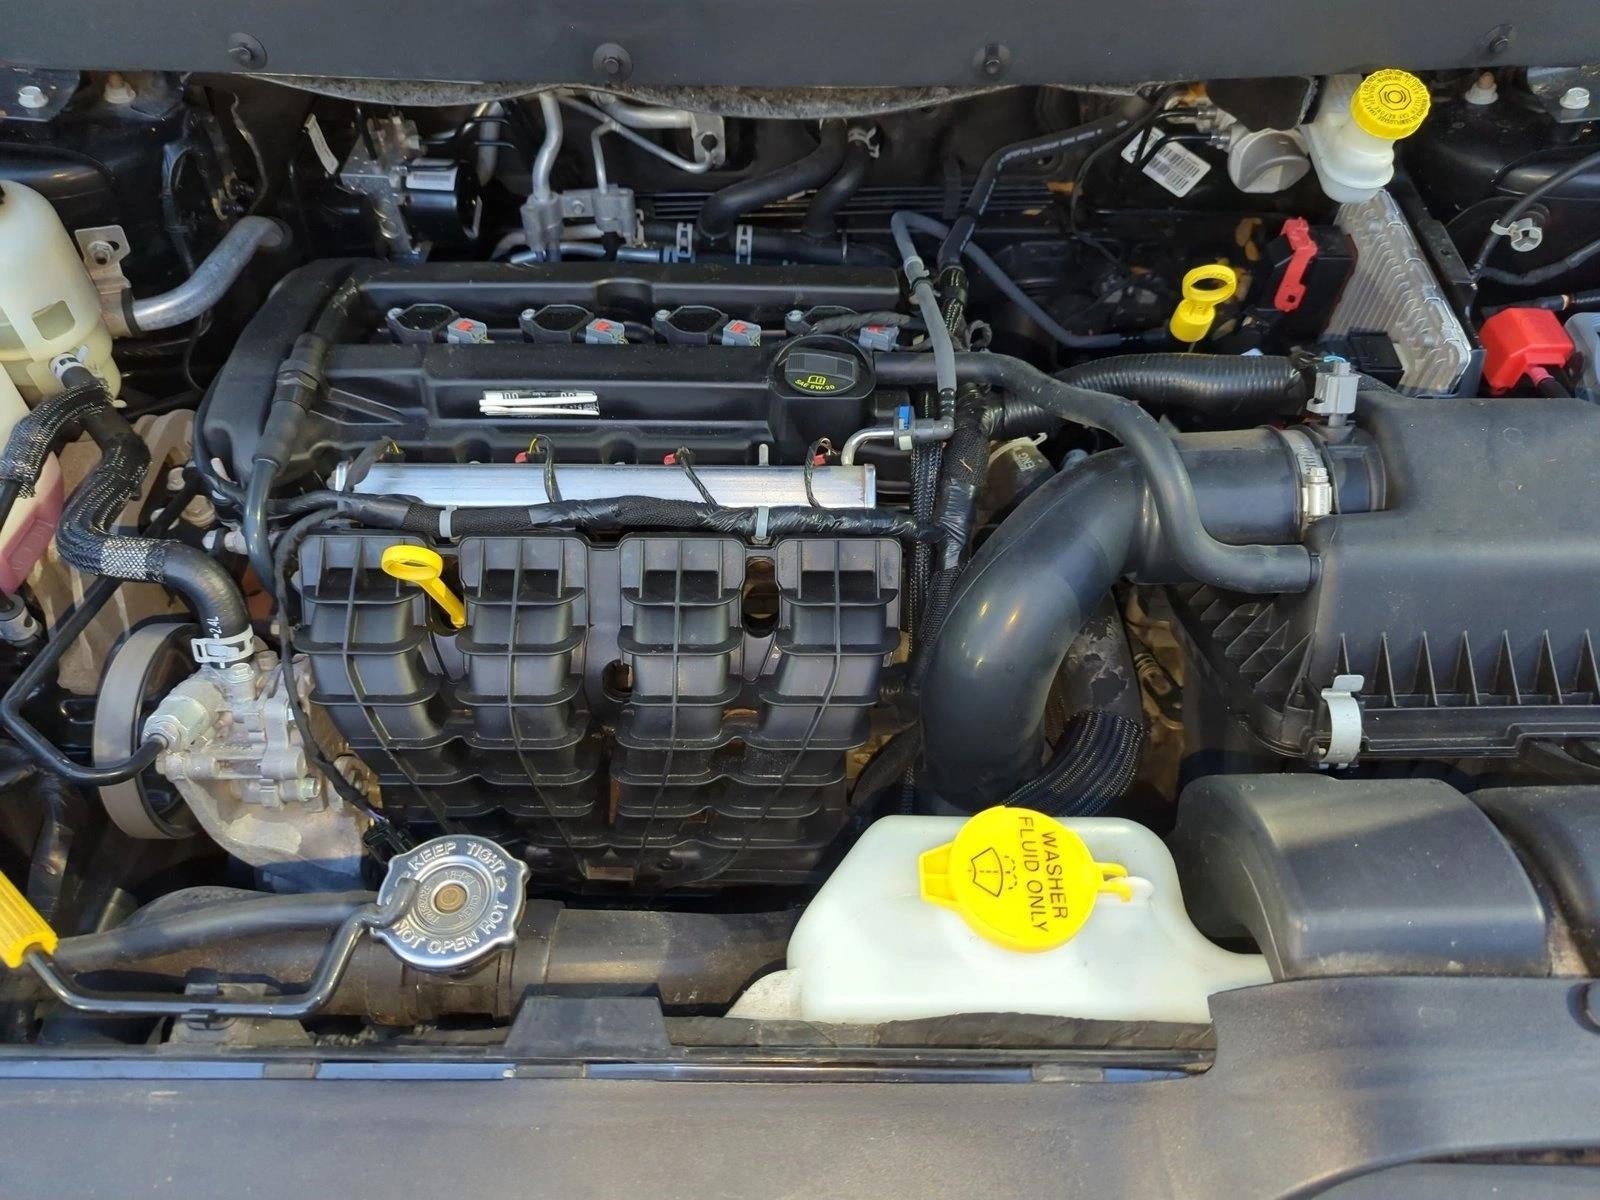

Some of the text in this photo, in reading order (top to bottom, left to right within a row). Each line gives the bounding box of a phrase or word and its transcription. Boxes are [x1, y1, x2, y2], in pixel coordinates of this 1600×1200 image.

[206, 616, 222, 634] 2.4L
[408, 842, 506, 873] KEEP TIGHT
[1018, 816, 1049, 932] FLUID ONLY
[1041, 831, 1068, 919] WASHER
[427, 929, 480, 955] OPEN
[479, 900, 509, 935] HOT
